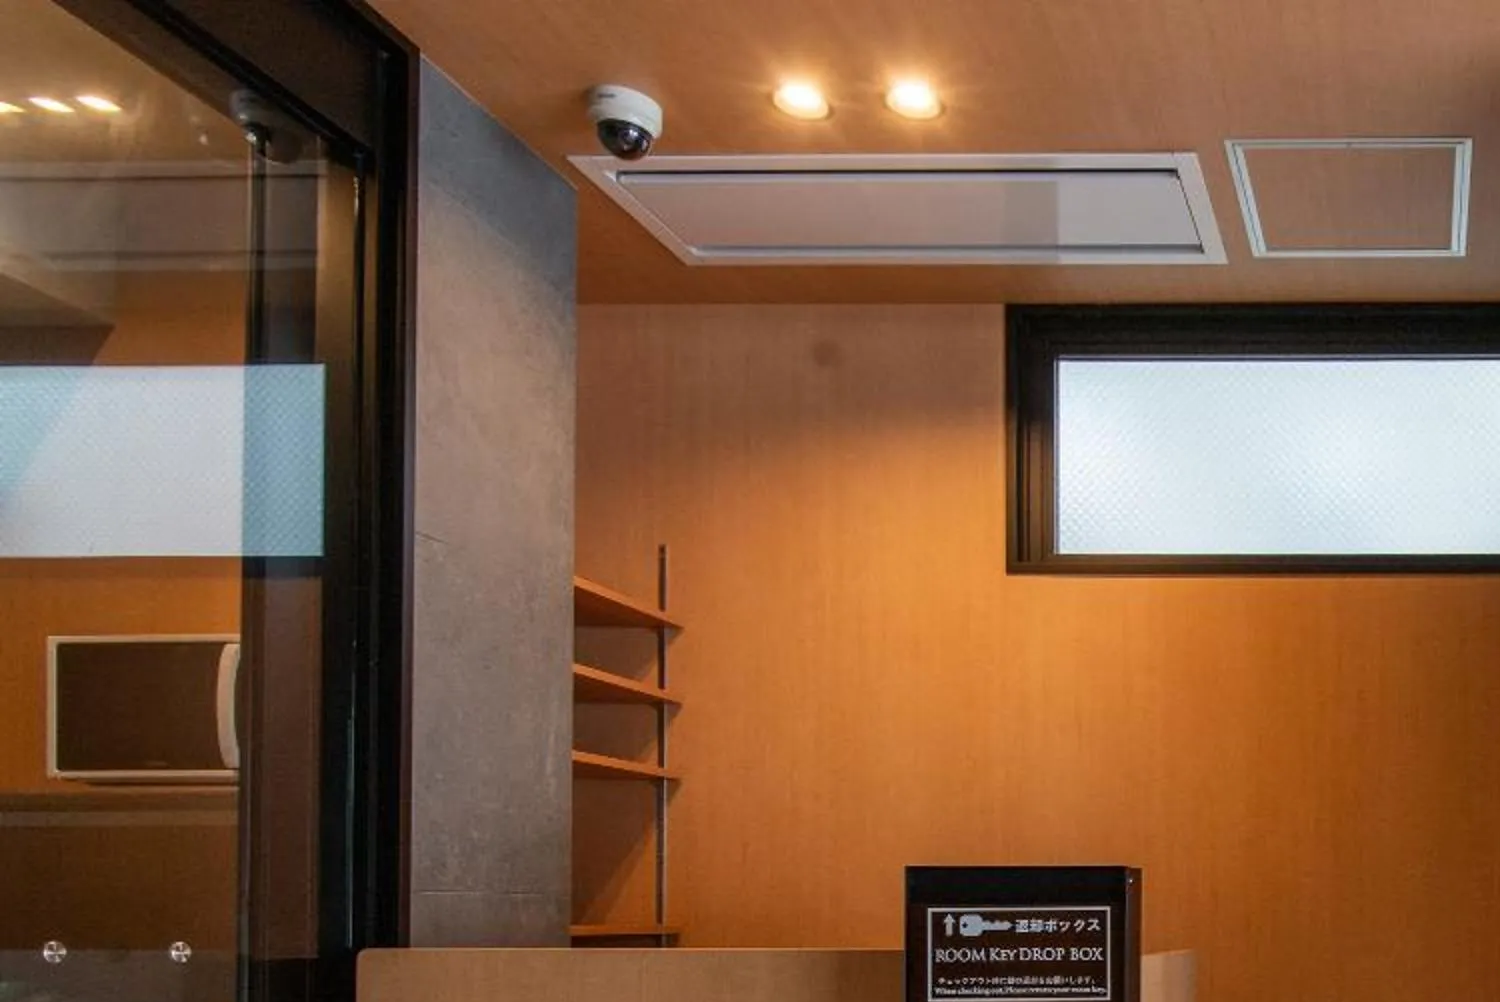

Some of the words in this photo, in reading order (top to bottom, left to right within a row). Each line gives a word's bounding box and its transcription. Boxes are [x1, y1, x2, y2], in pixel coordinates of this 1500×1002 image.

[935, 947, 986, 963] ROOM
[1019, 946, 1065, 962] DROP
[1070, 946, 1104, 962] BOX
